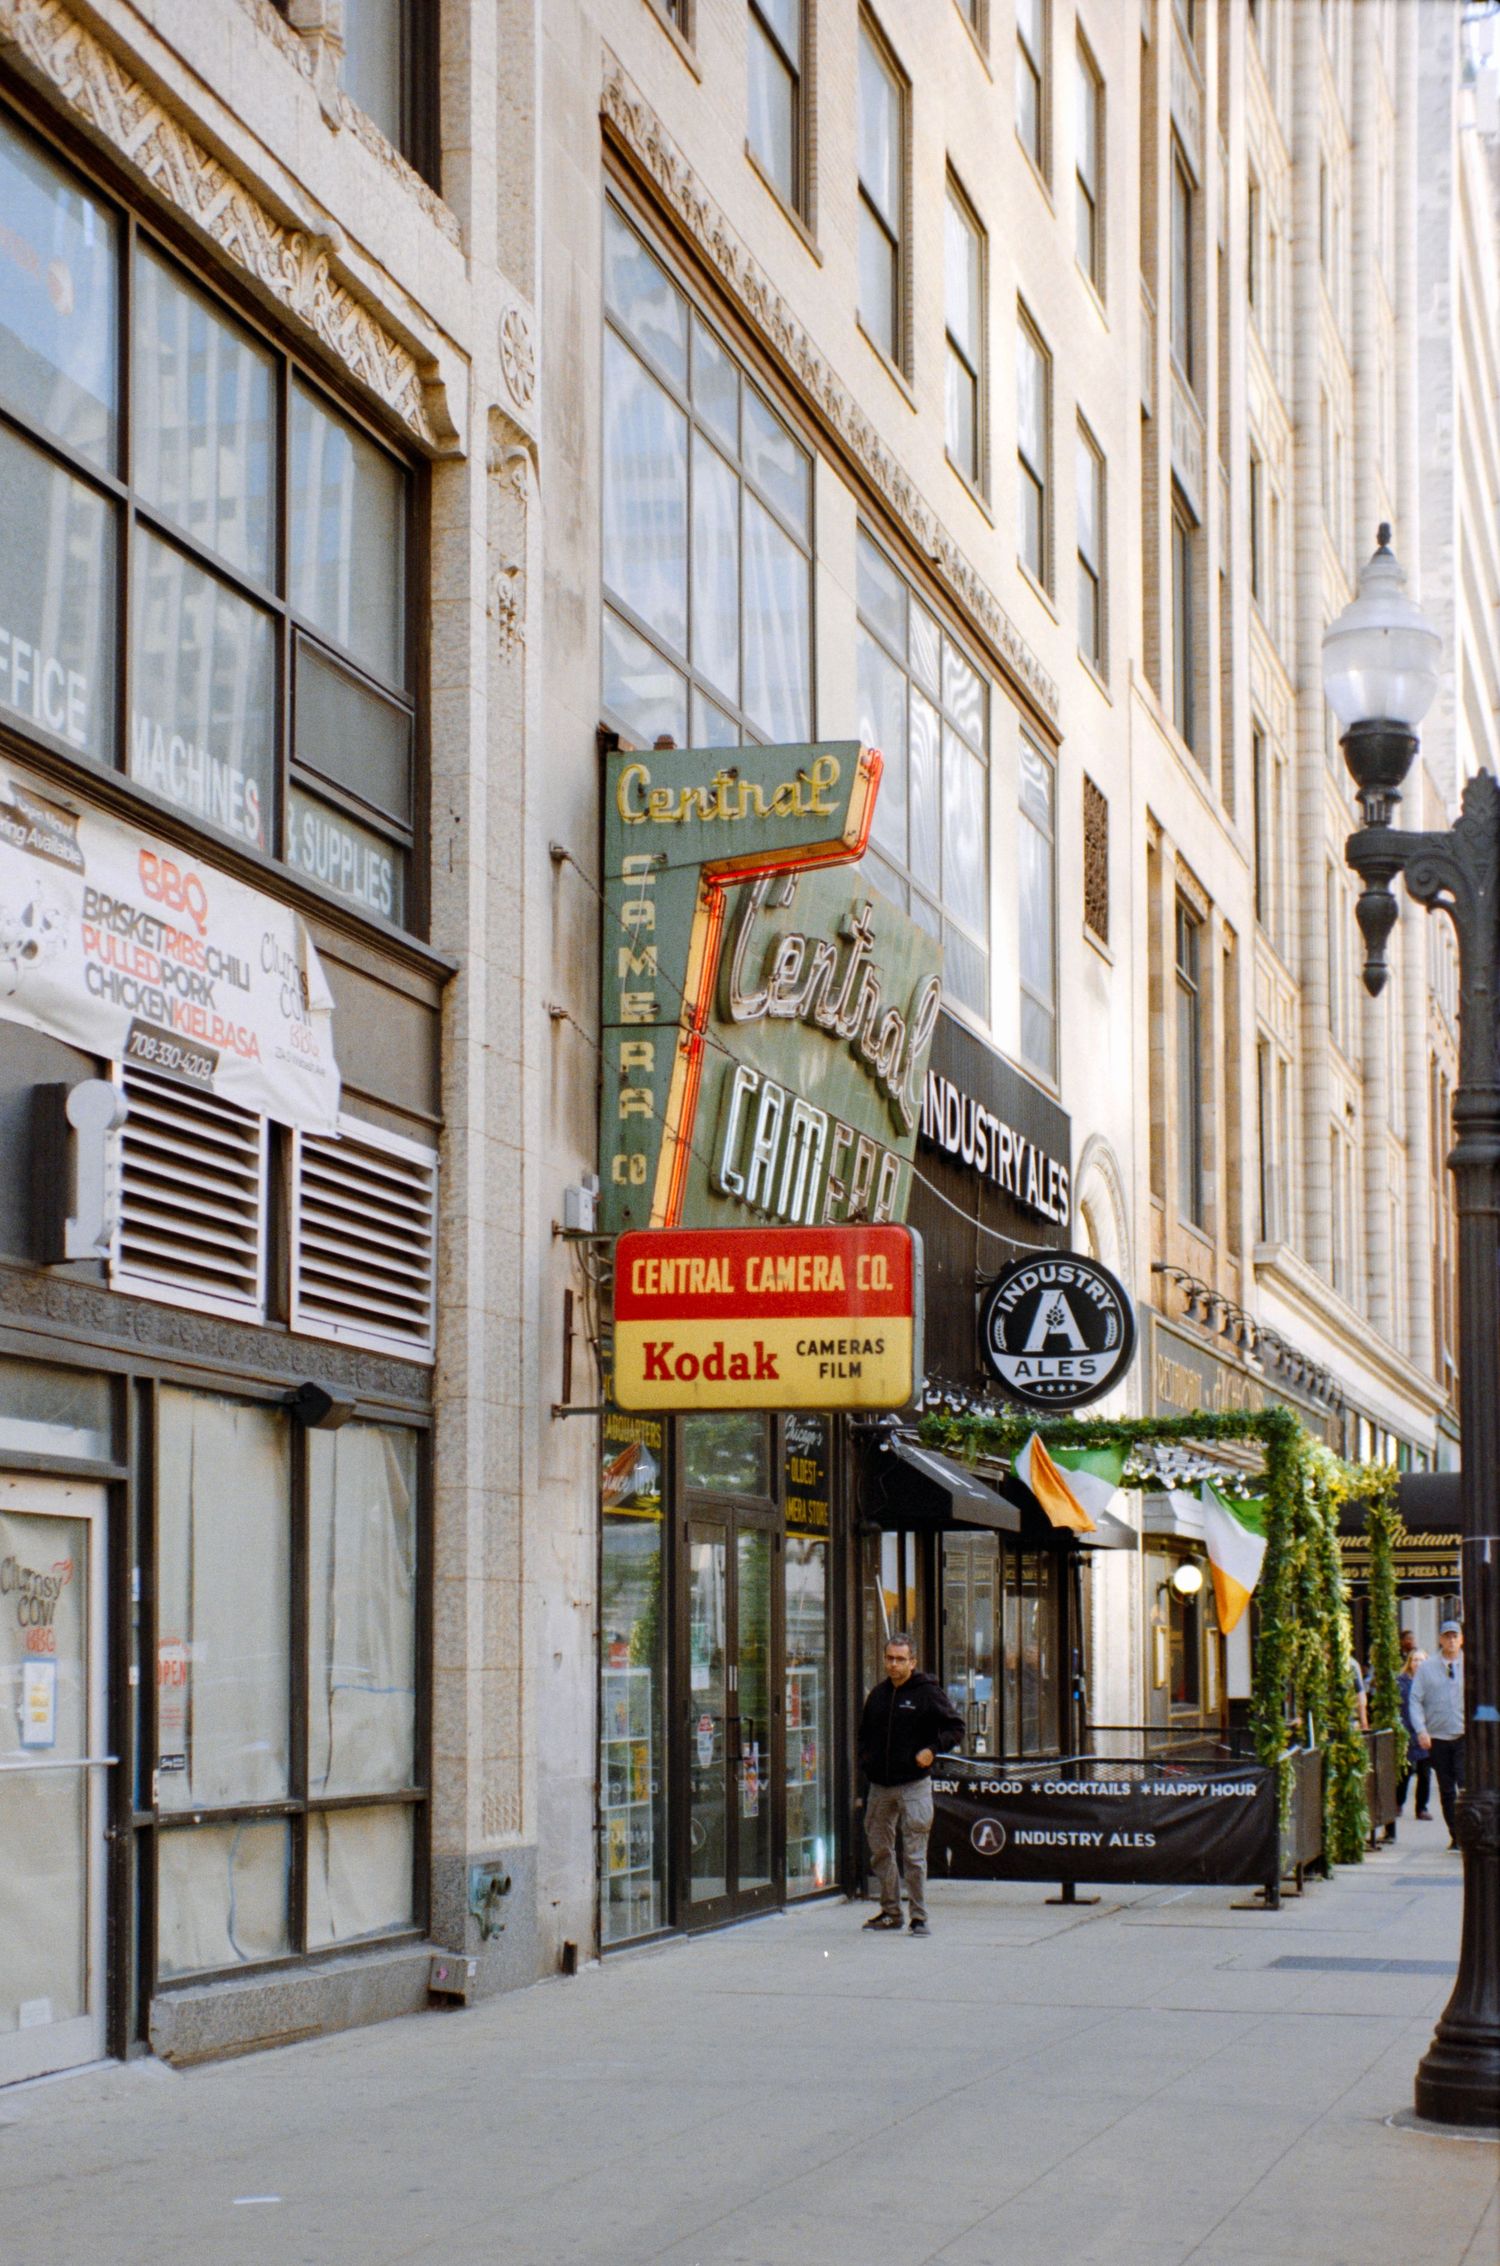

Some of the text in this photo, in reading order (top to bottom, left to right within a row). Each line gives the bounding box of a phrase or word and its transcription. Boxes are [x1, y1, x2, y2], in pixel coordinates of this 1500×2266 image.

[131, 710, 261, 842] MACHINES
[616, 754, 841, 825] Central
[302, 812, 393, 916] SUPPLIES
[139, 848, 208, 936] BBQ
[617, 853, 657, 1120] CAMERA
[716, 866, 942, 1138] Central
[712, 1064, 900, 1226] CAMERA
[922, 1069, 1070, 1228] INDUSTRY ALES
[611, 1153, 647, 1186] CO
[631, 1254, 894, 1295] CENTRAL CAMERA CO.
[997, 1264, 1117, 1313] INDUSTRY
[642, 1340, 780, 1382] Kodak
[796, 1338, 885, 1357] CAMERAS
[818, 1361, 863, 1379] FILM
[1014, 1360, 1098, 1378] ALES
[1389, 1524, 1462, 1547] Restaur
[980, 1782, 1024, 1795] FOOD
[1043, 1782, 1131, 1796] COCKTAILS
[1153, 1782, 1208, 1797] HAPPY
[1209, 1782, 1258, 1797] HOUR
[1014, 1830, 1105, 1847] INDUSTRY
[1108, 1831, 1157, 1848] ALES
